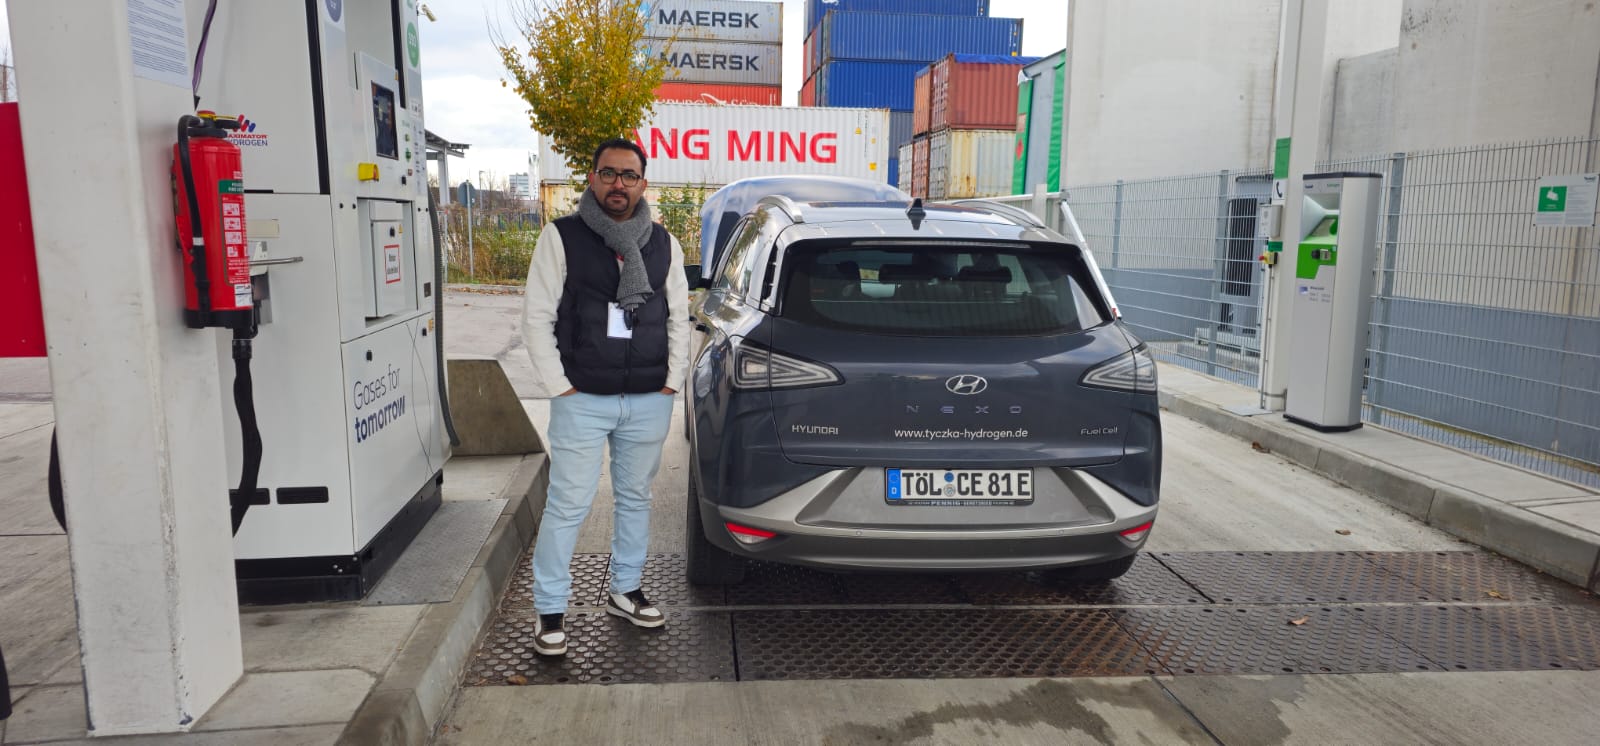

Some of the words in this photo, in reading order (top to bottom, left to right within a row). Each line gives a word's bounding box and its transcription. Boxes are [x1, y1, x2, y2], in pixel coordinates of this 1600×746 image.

[659, 9, 759, 28] MAERSK
[660, 52, 759, 71] MAERSK
[632, 127, 710, 160] ANG
[727, 130, 838, 164] MING
[353, 376, 387, 410] Gases
[387, 363, 400, 391] for
[355, 395, 405, 443] tomorrow
[906, 405, 1022, 414] NEXO
[791, 424, 839, 435] HYUNDAI
[894, 428, 1029, 441] www.tyczka-hydrogen.de
[1080, 427, 1101, 435] Fuel
[1102, 426, 1118, 434] Cell
[901, 472, 942, 496] TÖL
[957, 472, 984, 496] CE
